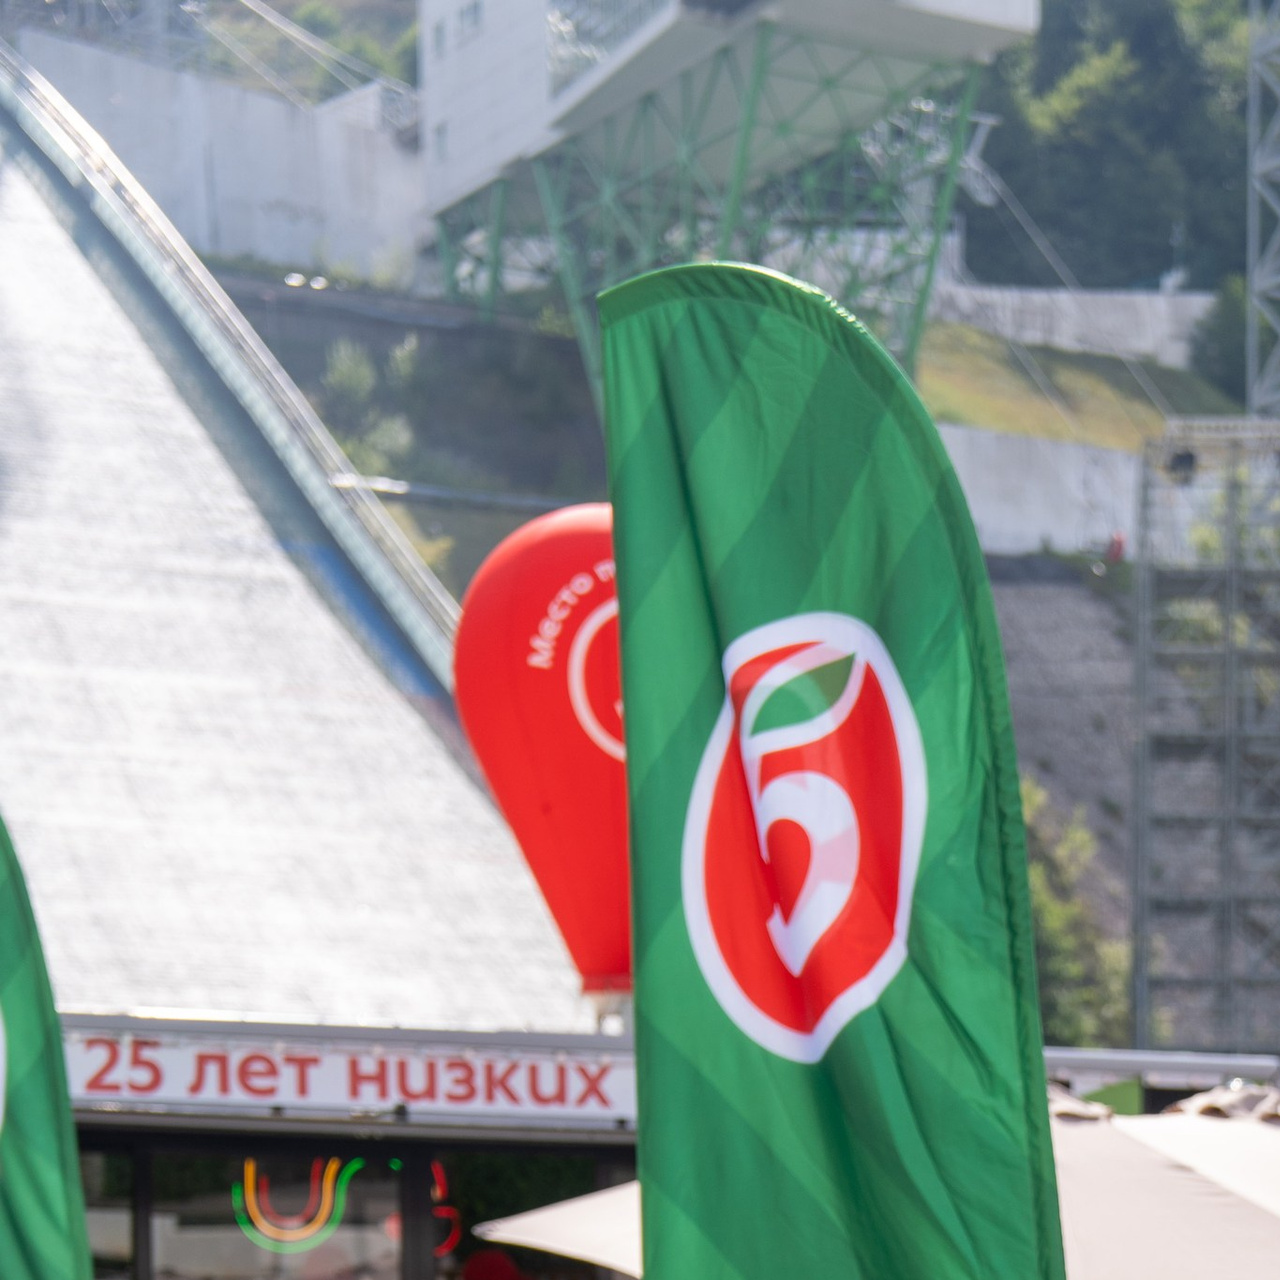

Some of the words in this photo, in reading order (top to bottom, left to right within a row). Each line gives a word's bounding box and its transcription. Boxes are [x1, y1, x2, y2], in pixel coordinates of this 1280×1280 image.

[526, 571, 594, 669] Место
[84, 1037, 163, 1095] 25
[187, 1052, 321, 1099] лет
[348, 1055, 613, 1109] низких
